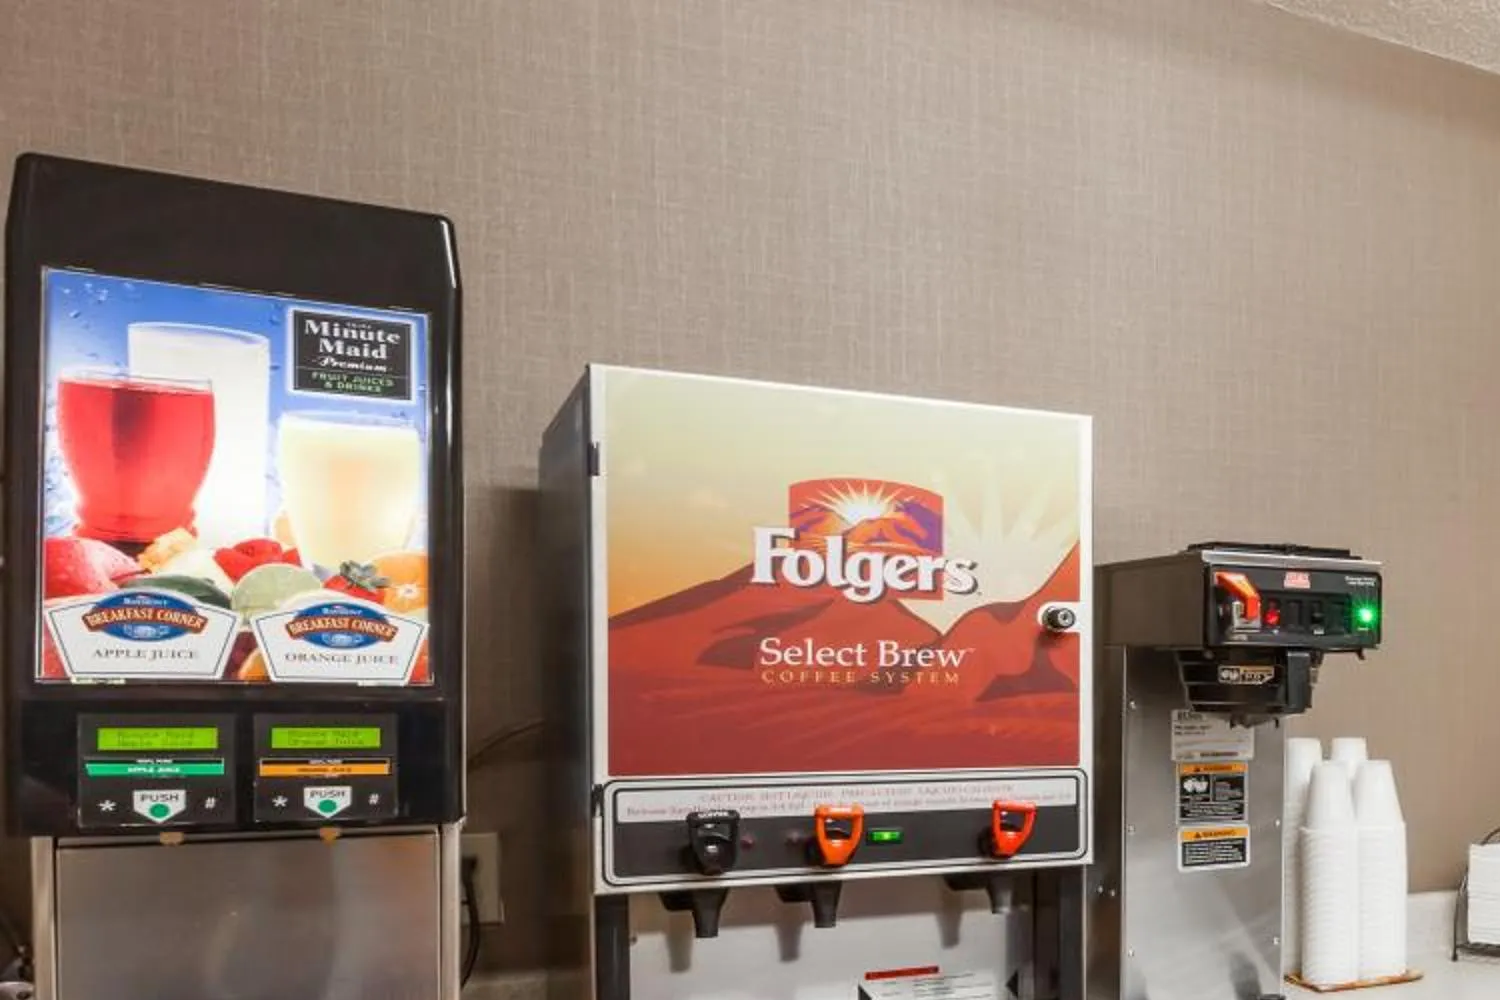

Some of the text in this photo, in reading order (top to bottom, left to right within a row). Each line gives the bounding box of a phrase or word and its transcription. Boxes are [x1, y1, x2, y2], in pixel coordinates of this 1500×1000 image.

[305, 319, 401, 345] Minute
[319, 338, 387, 359] Maid
[318, 356, 387, 372] Premium
[752, 526, 979, 604] Folgers
[86, 607, 204, 629] BREAKFAST CORNER
[288, 618, 350, 636] BREAKFAST
[93, 648, 199, 661] APPLE JUICE
[284, 652, 399, 665] ORANGE JUICE
[760, 636, 967, 669] Select Brew
[761, 671, 961, 684] COFFEE SYSTEM
[140, 793, 180, 801] PUSH
[309, 790, 346, 799] PUSH
